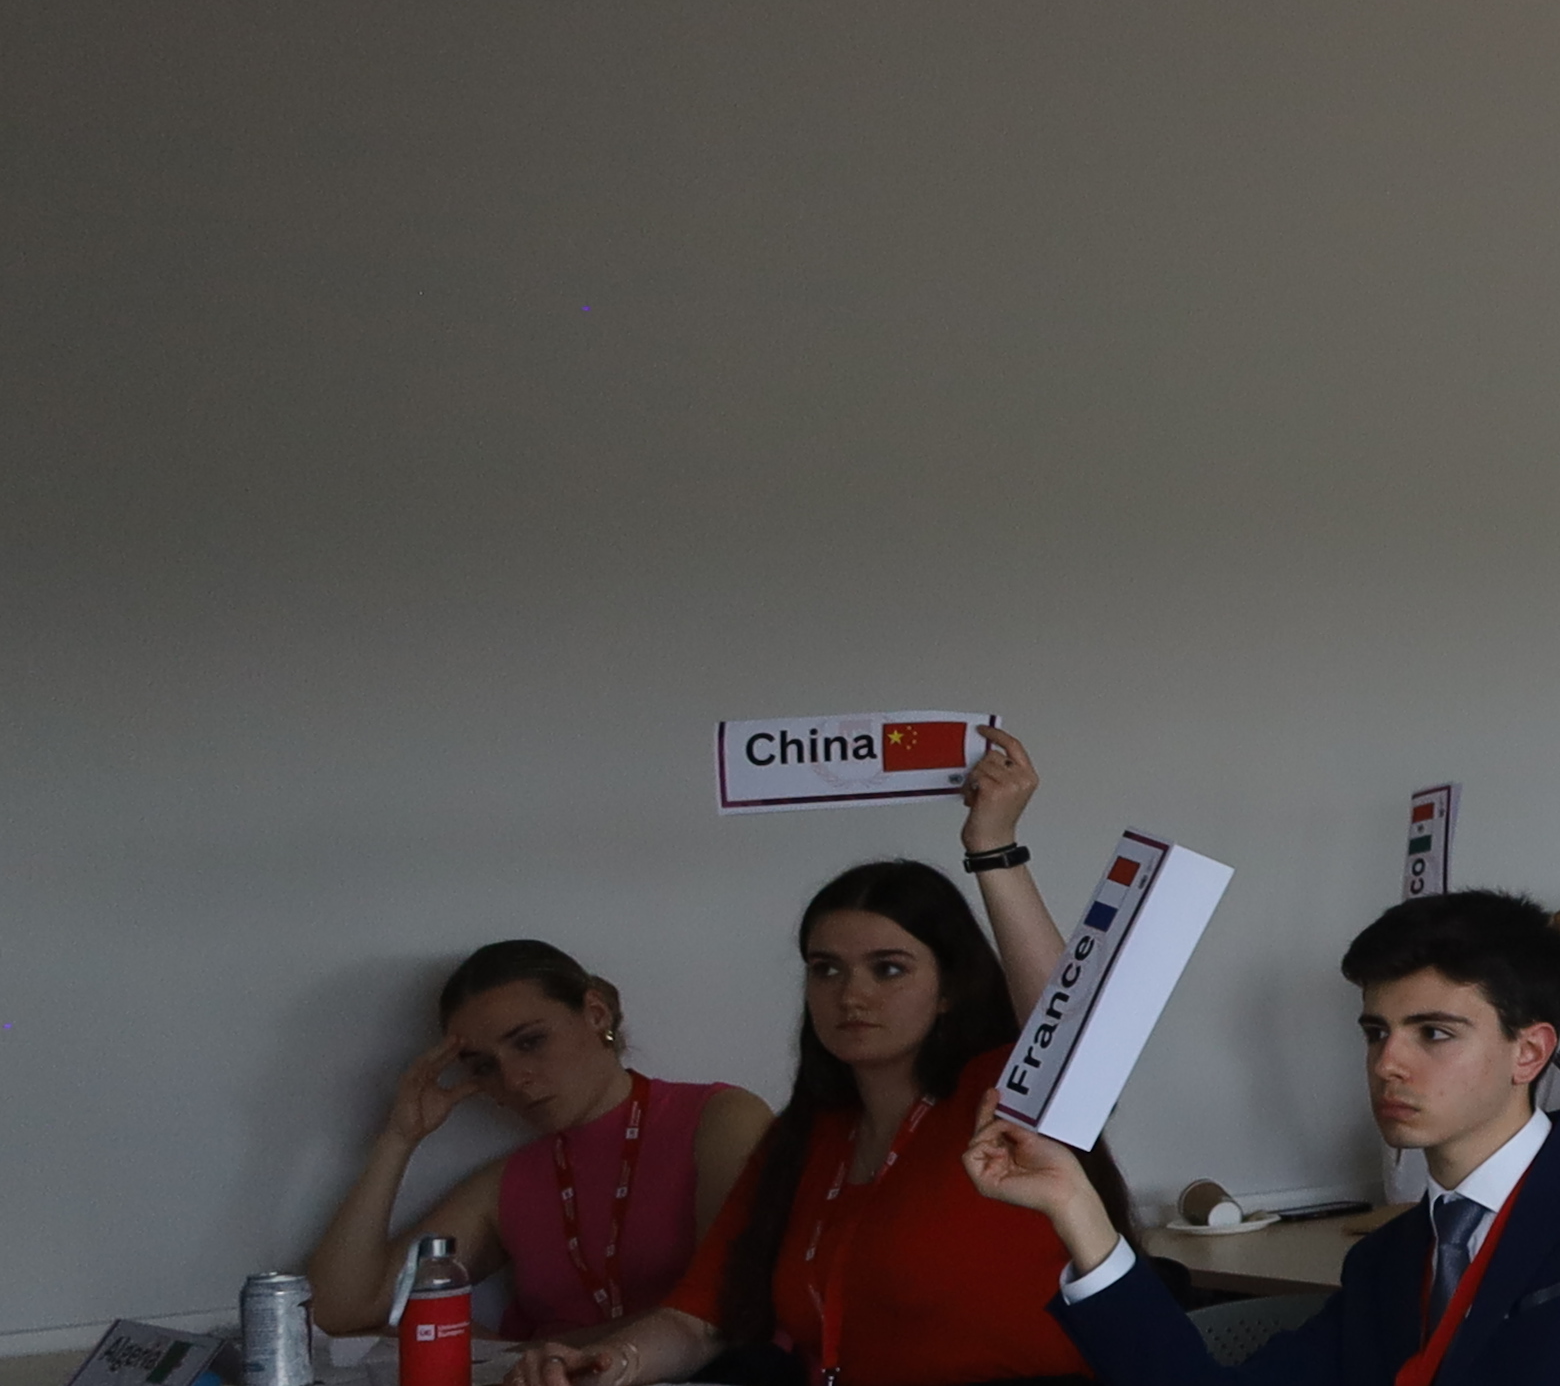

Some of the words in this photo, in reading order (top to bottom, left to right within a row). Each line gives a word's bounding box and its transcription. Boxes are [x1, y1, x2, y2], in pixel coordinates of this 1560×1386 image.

[745, 727, 877, 767] China
[1005, 933, 1096, 1098] France
[98, 1336, 161, 1373] Algeria
